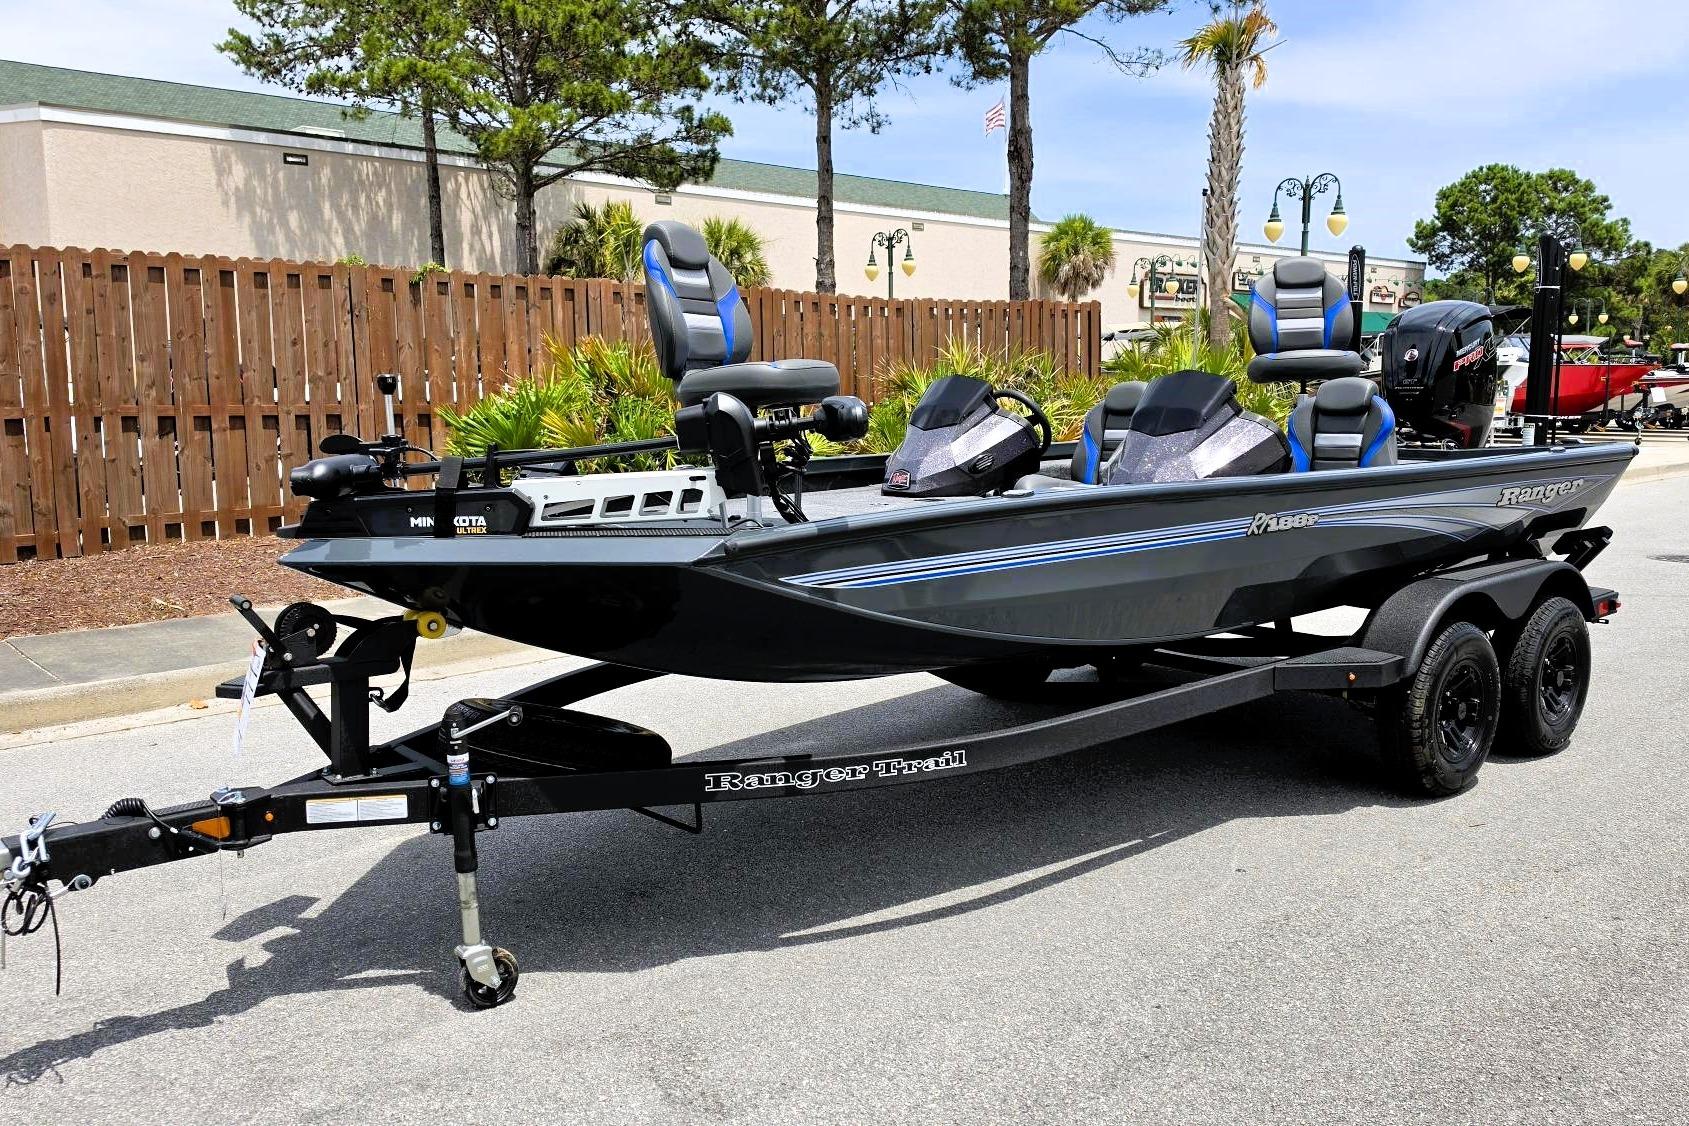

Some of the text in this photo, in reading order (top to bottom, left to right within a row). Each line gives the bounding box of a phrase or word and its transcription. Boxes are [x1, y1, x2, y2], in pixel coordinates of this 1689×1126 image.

[1496, 478, 1584, 507] Ranger
[409, 516, 435, 528] MIN
[456, 526, 487, 534] ULTREX
[705, 750, 967, 791] Ranger Trail
